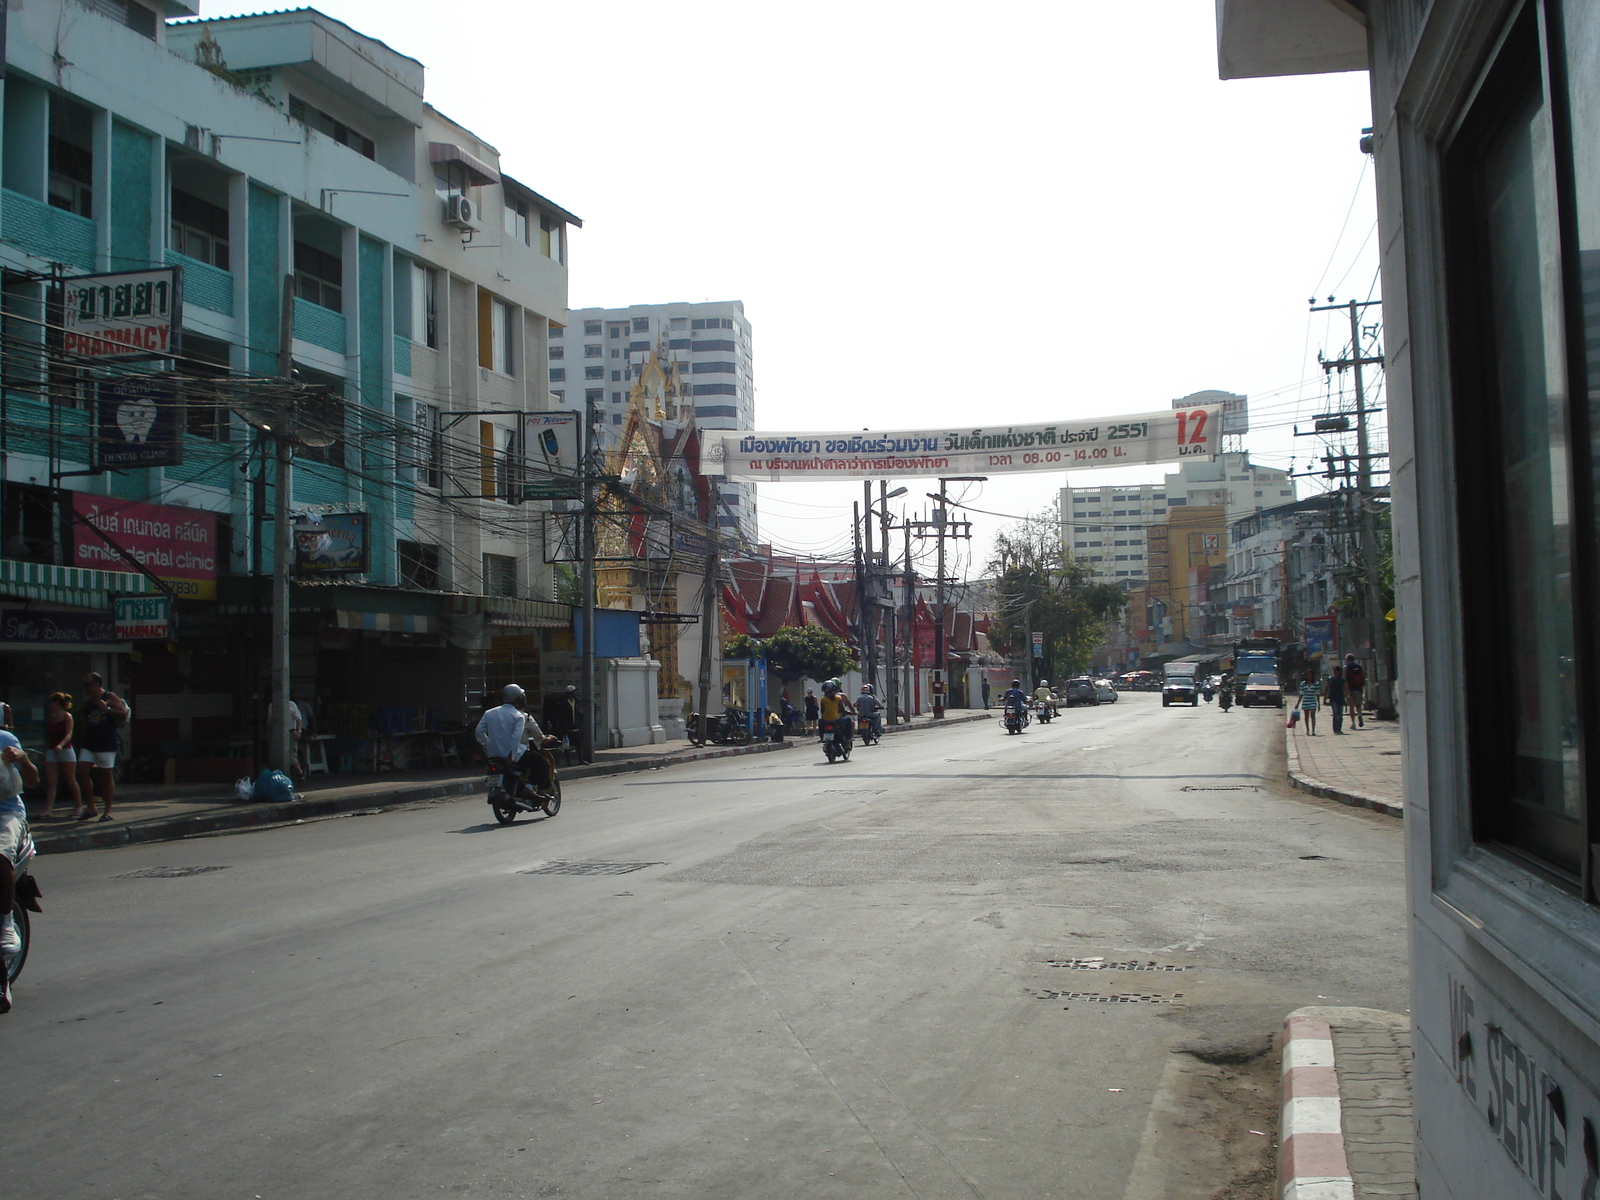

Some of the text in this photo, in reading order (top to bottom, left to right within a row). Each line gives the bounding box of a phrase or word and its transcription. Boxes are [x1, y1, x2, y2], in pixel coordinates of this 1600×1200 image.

[78, 281, 169, 323] ขายยา
[65, 325, 170, 355] PHARMACY
[740, 422, 1147, 454] เมืองพัทยา ขอเชิญร่วมงาน วันเด็กแห่งชาติ ประจำปี 2551
[1175, 409, 1208, 445] 12
[104, 449, 169, 462] DENTAL CLINIC
[749, 460, 762, 470] ณ
[989, 454, 1012, 466] เวลา
[1113, 446, 1127, 457] น.
[1179, 444, 1206, 456] ม.ค.
[78, 542, 214, 571] smile dental clinic
[115, 598, 168, 620] ขายยา
[115, 625, 168, 638] PHARMACY
